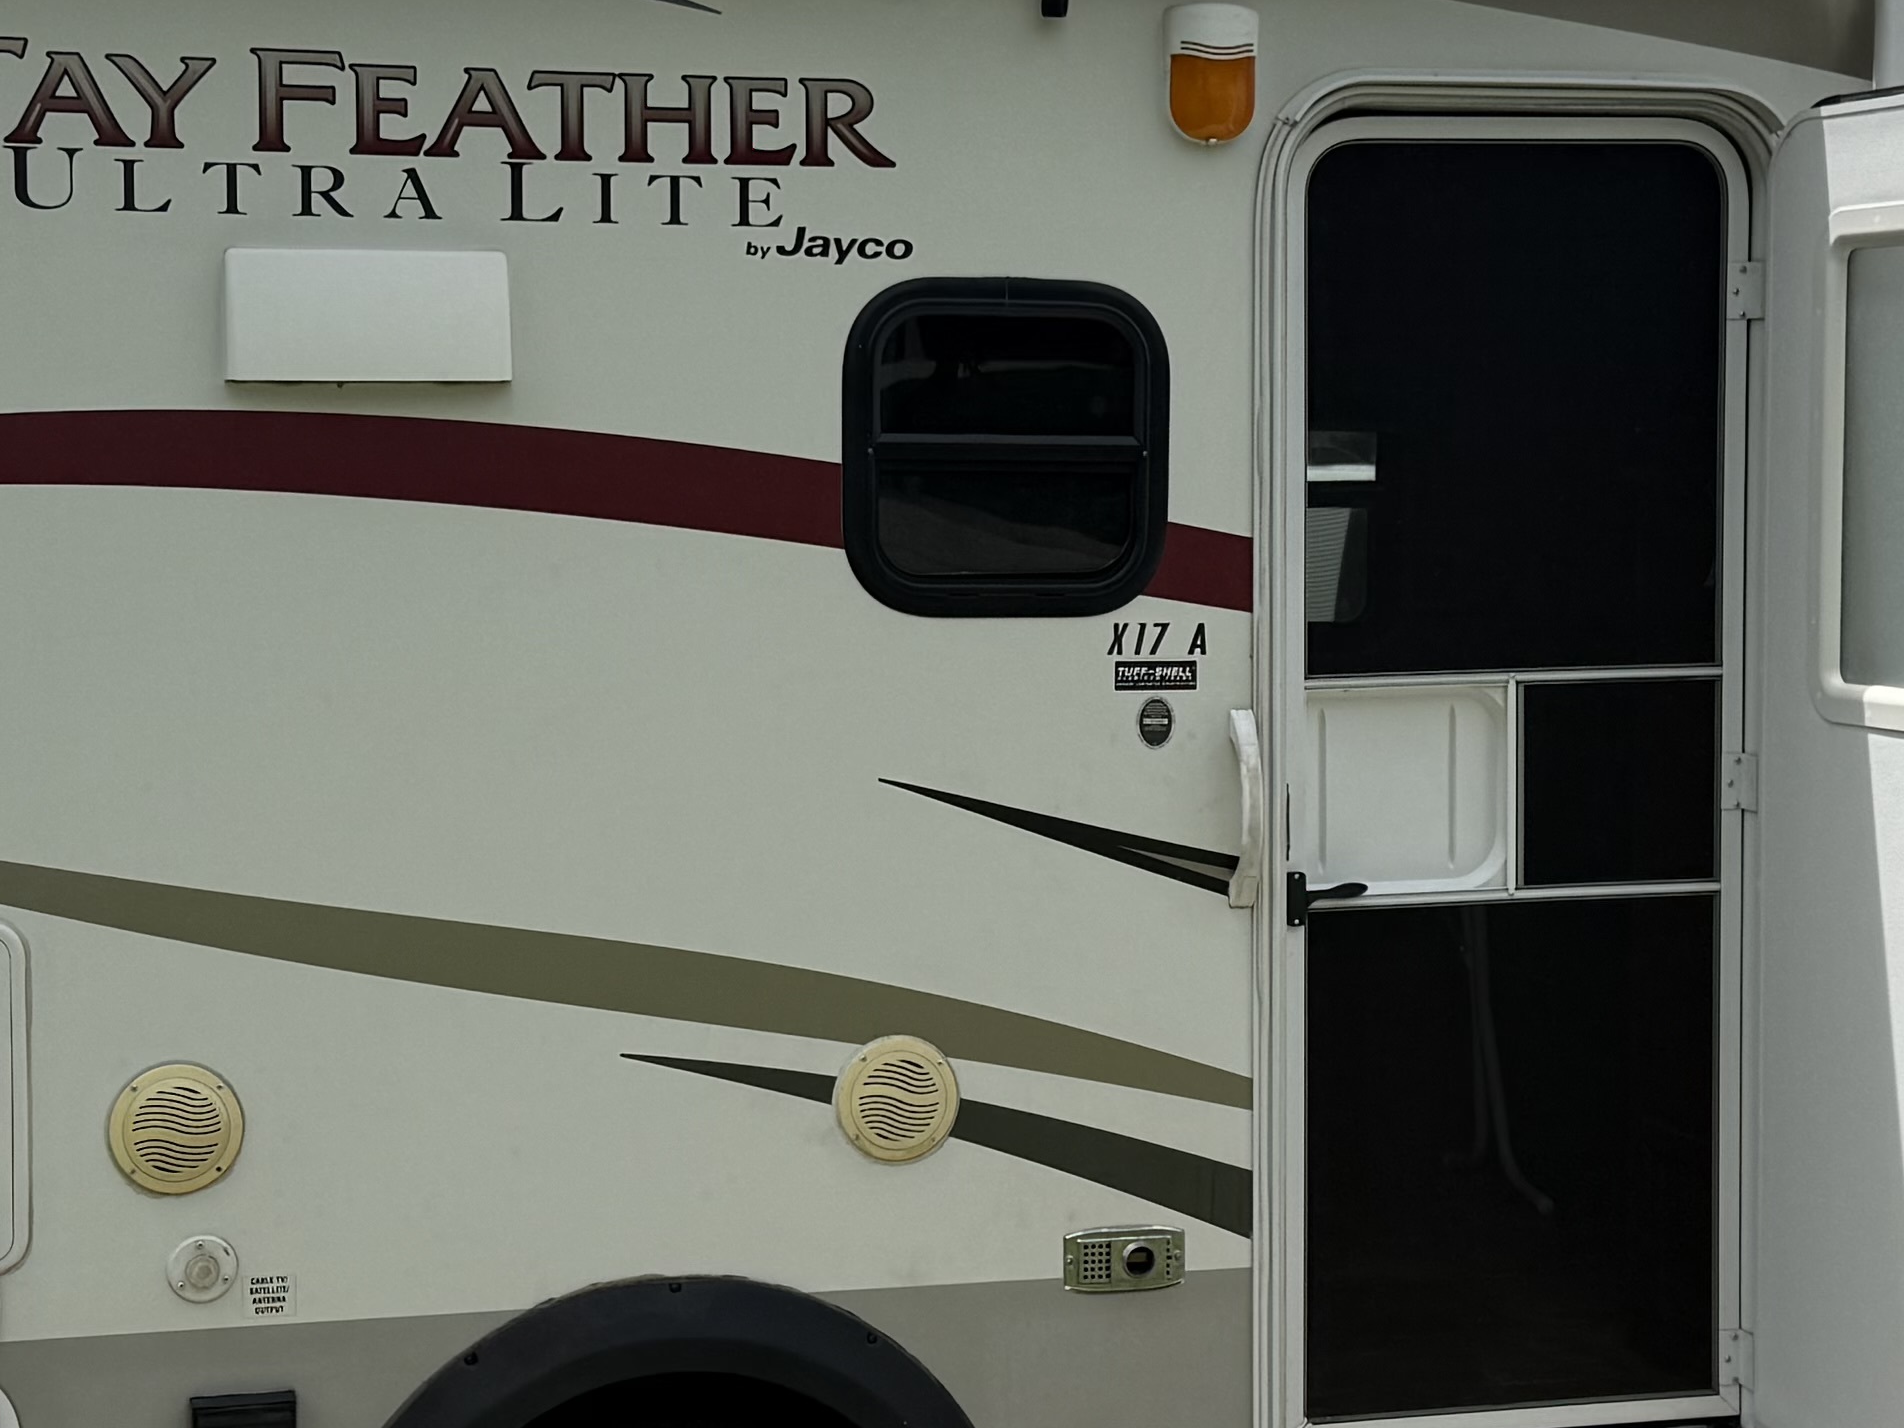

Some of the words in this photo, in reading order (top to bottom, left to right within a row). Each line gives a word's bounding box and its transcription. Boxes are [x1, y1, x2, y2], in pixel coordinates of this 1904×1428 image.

[249, 48, 897, 169] FEATHER
[4, 146, 443, 220] ULTRA
[500, 161, 784, 228] LITE
[745, 241, 772, 260] by
[775, 226, 914, 266] Jayco
[1106, 622, 1171, 656] X17
[1187, 622, 1207, 656] A
[1117, 666, 1192, 678] TUFF-SHELL
[254, 1305, 284, 1315] OUTPUT
